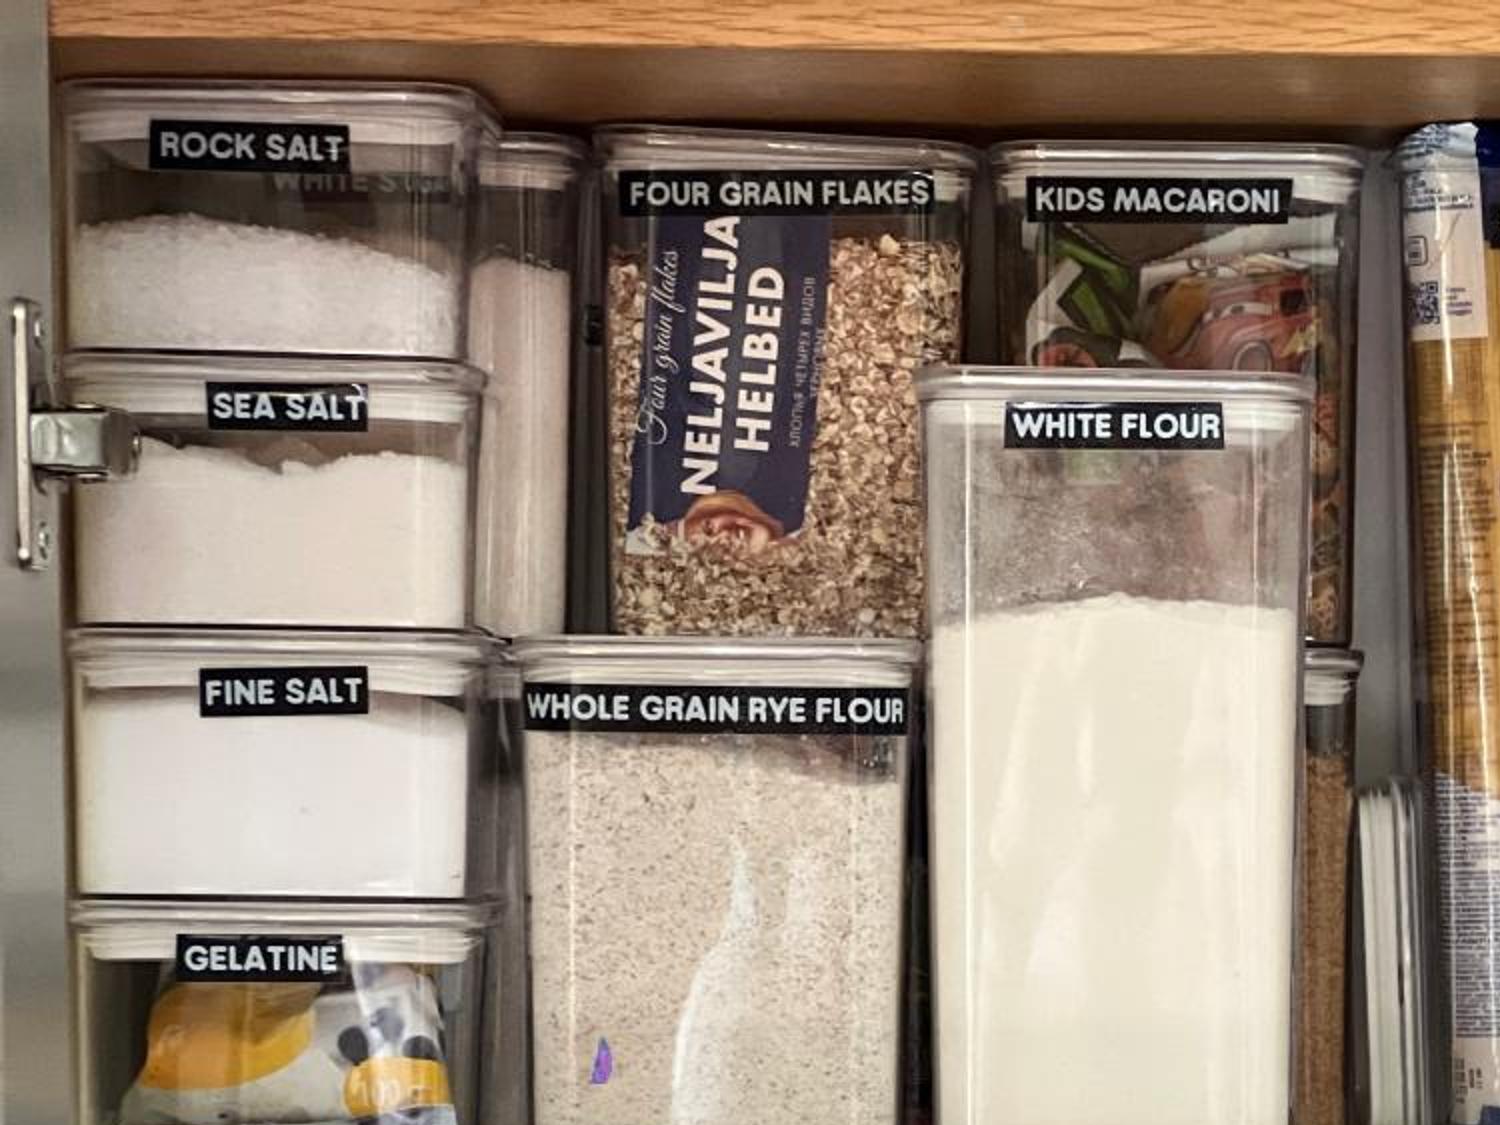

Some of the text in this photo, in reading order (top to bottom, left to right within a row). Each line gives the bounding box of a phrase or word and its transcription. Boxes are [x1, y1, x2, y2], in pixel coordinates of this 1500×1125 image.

[160, 131, 344, 161] ROCK SALT
[630, 181, 929, 207] FOUR GRAIN FLAKES
[1035, 188, 1279, 214] KIDS MACARONI
[680, 216, 740, 495] NELJAVILJA
[733, 266, 785, 452] HELBED
[213, 393, 365, 421] SEA SALT
[1011, 413, 1220, 439] WHITE FLOUR
[205, 678, 363, 706] FINE SALT
[527, 693, 903, 724] WHOLE GRAIN RYE FLOUR
[184, 945, 338, 974] GELATINE
